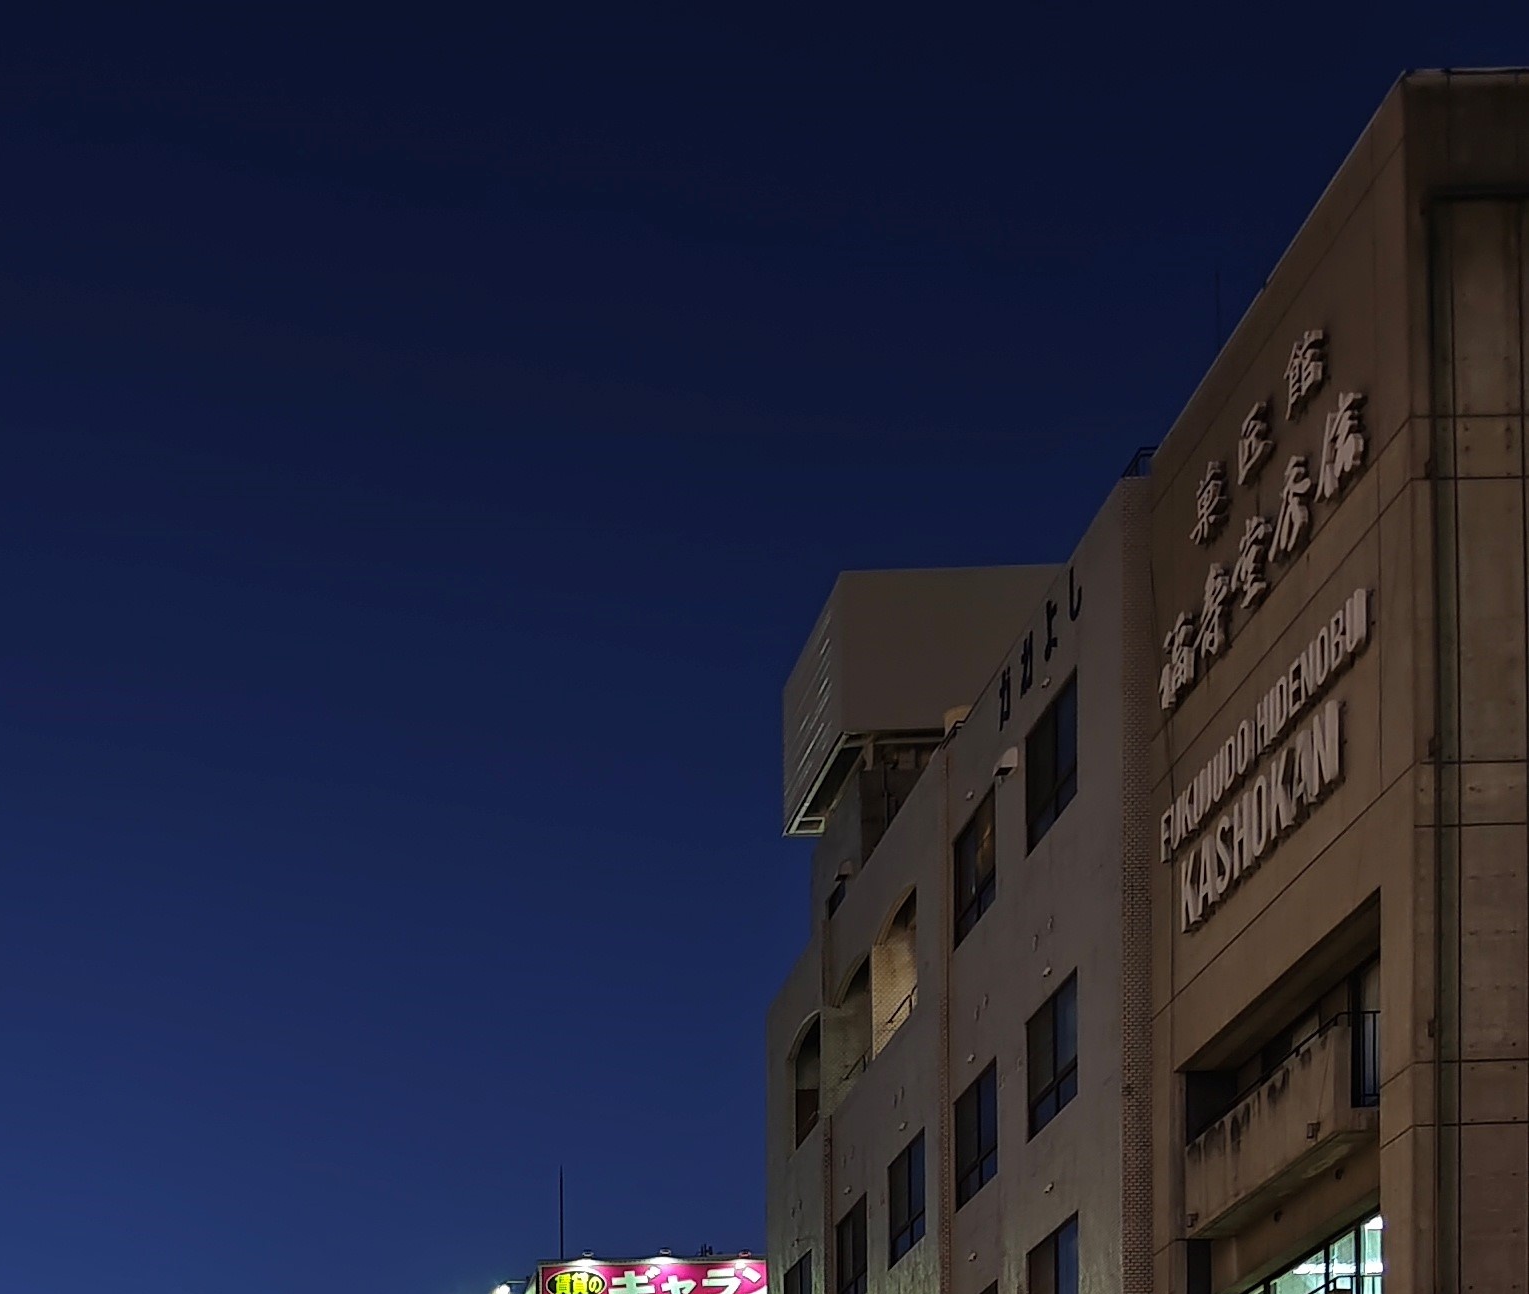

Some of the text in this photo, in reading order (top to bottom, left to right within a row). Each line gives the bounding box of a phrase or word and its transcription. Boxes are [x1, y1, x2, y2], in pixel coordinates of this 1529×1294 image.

[1160, 588, 1368, 864] FUKUJUDO HIDENOBU
[1181, 700, 1340, 933] KASHOKAN
